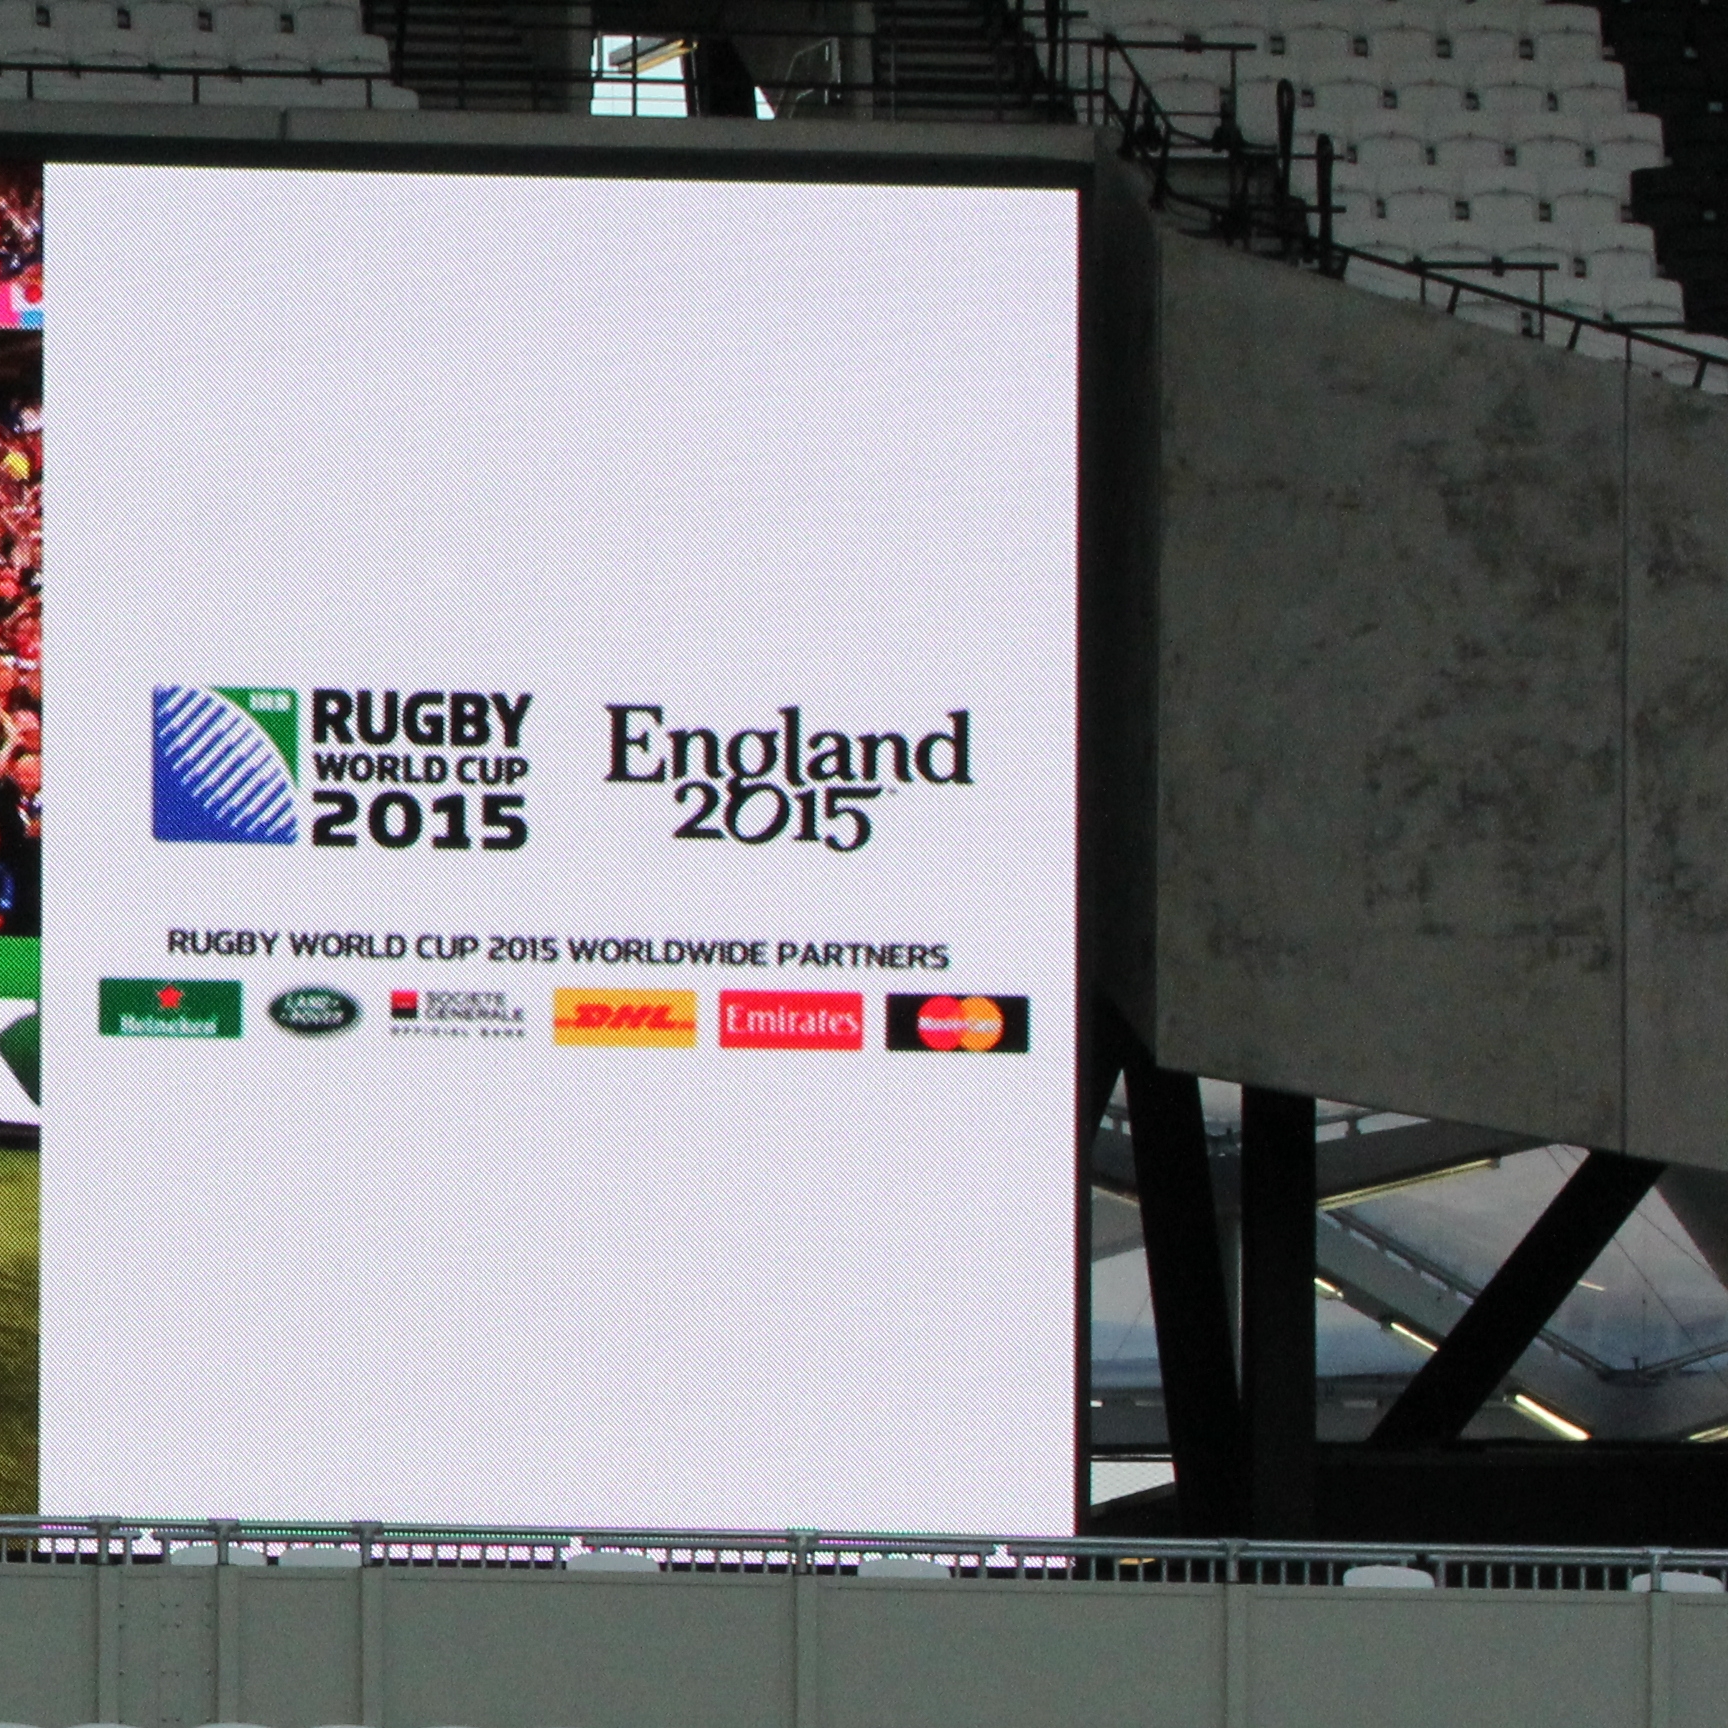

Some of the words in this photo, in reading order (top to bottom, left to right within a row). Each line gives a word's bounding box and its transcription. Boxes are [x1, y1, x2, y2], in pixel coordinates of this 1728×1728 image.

[312, 688, 533, 748] RUGBY
[313, 752, 446, 784] WORLD
[456, 756, 529, 786] CUP
[604, 703, 974, 788] England
[312, 790, 528, 851] 2015
[674, 780, 883, 854] 2015
[168, 928, 279, 957] RUGBY
[290, 931, 407, 959] WORLD
[416, 934, 478, 961] CUP
[488, 936, 559, 963] 2015
[568, 937, 769, 966] WORLDWIDE
[778, 941, 950, 970] PARTNERS
[572, 1003, 676, 1031] DHL
[725, 1004, 860, 1037] Emirates
